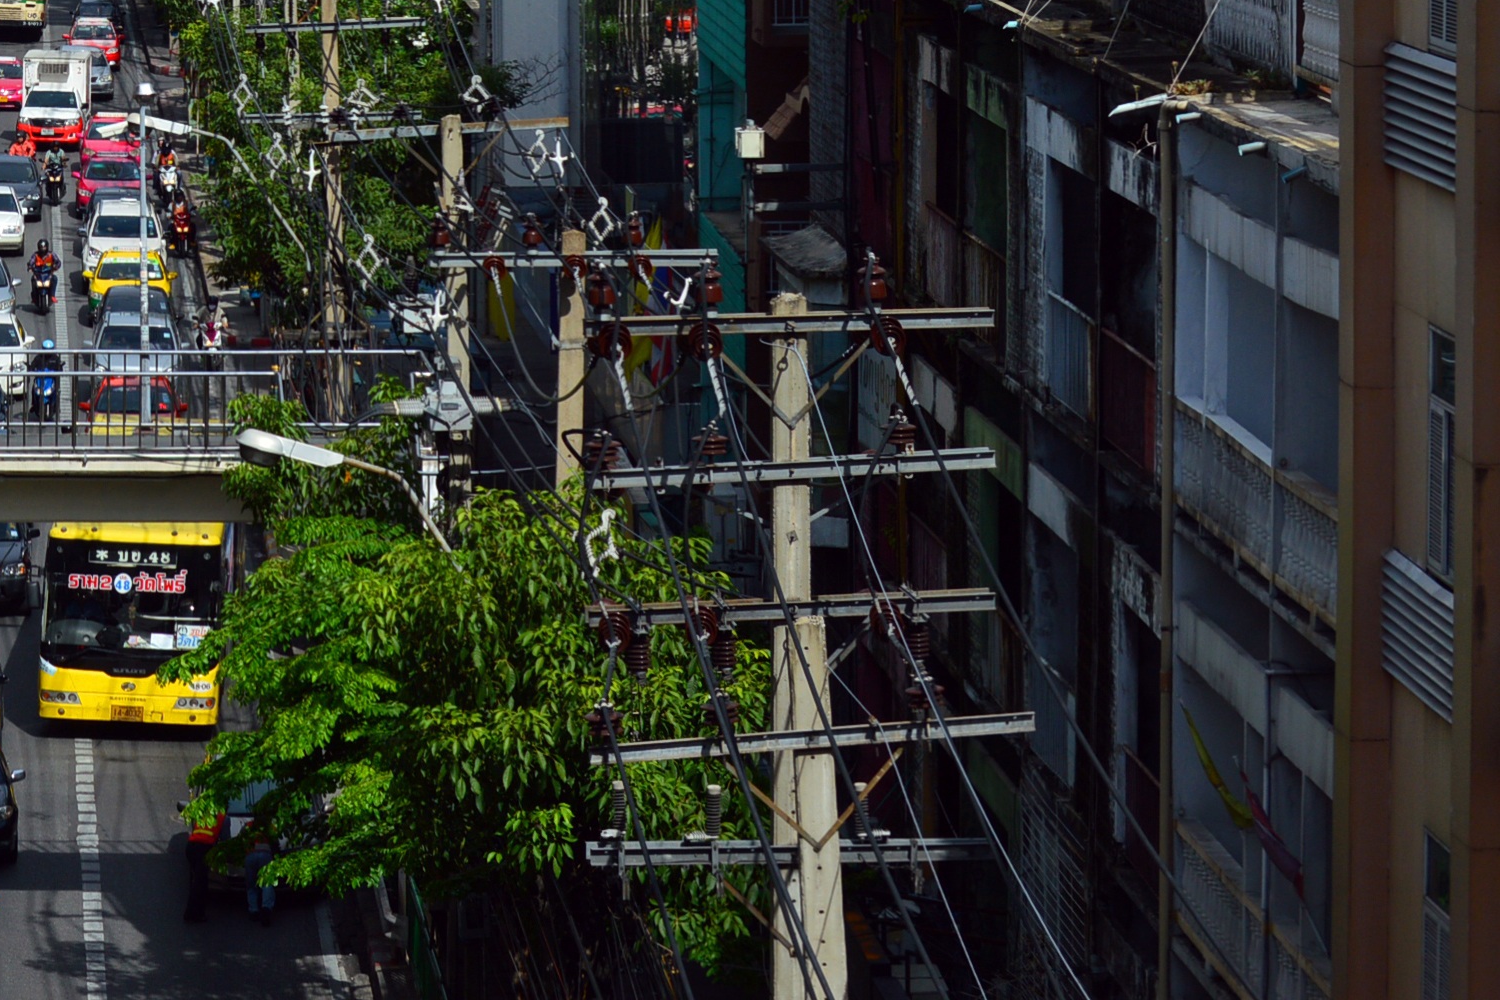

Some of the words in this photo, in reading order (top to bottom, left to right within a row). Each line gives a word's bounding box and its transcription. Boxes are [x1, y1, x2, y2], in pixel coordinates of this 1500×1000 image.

[68, 573, 113, 590] ราม2
[115, 580, 131, 590] 48
[132, 569, 188, 593] วัดโพธิ์
